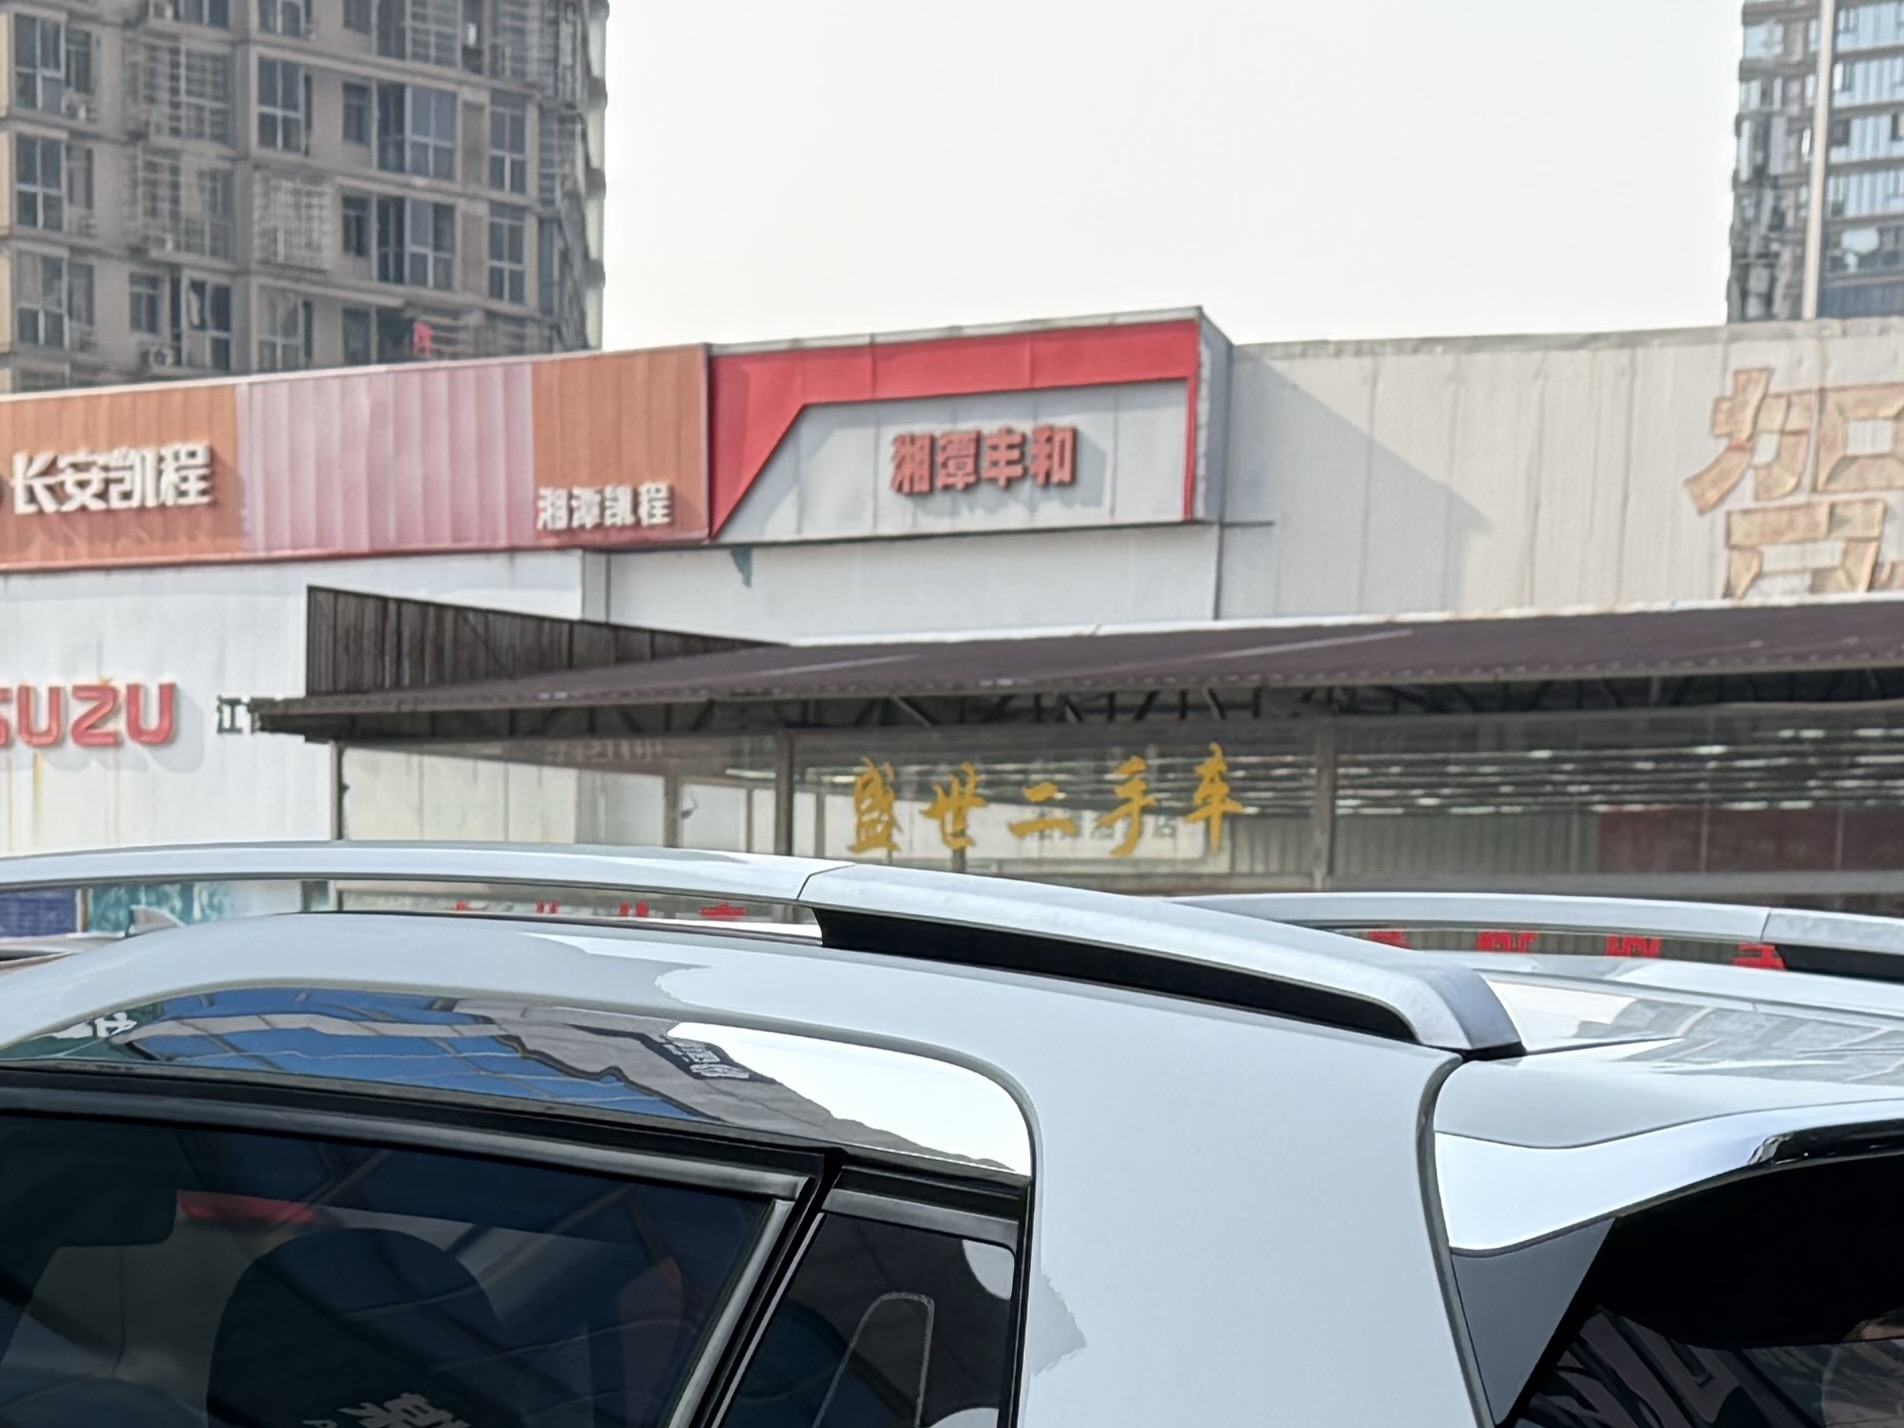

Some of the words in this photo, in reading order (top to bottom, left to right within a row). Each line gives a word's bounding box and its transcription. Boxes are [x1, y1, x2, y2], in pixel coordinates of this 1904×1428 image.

[11, 441, 213, 515] 长安凯程
[890, 424, 1079, 496] 湘潭丰和
[536, 482, 673, 532] 湘潭凯程
[847, 742, 1246, 857] 盛世二手车
